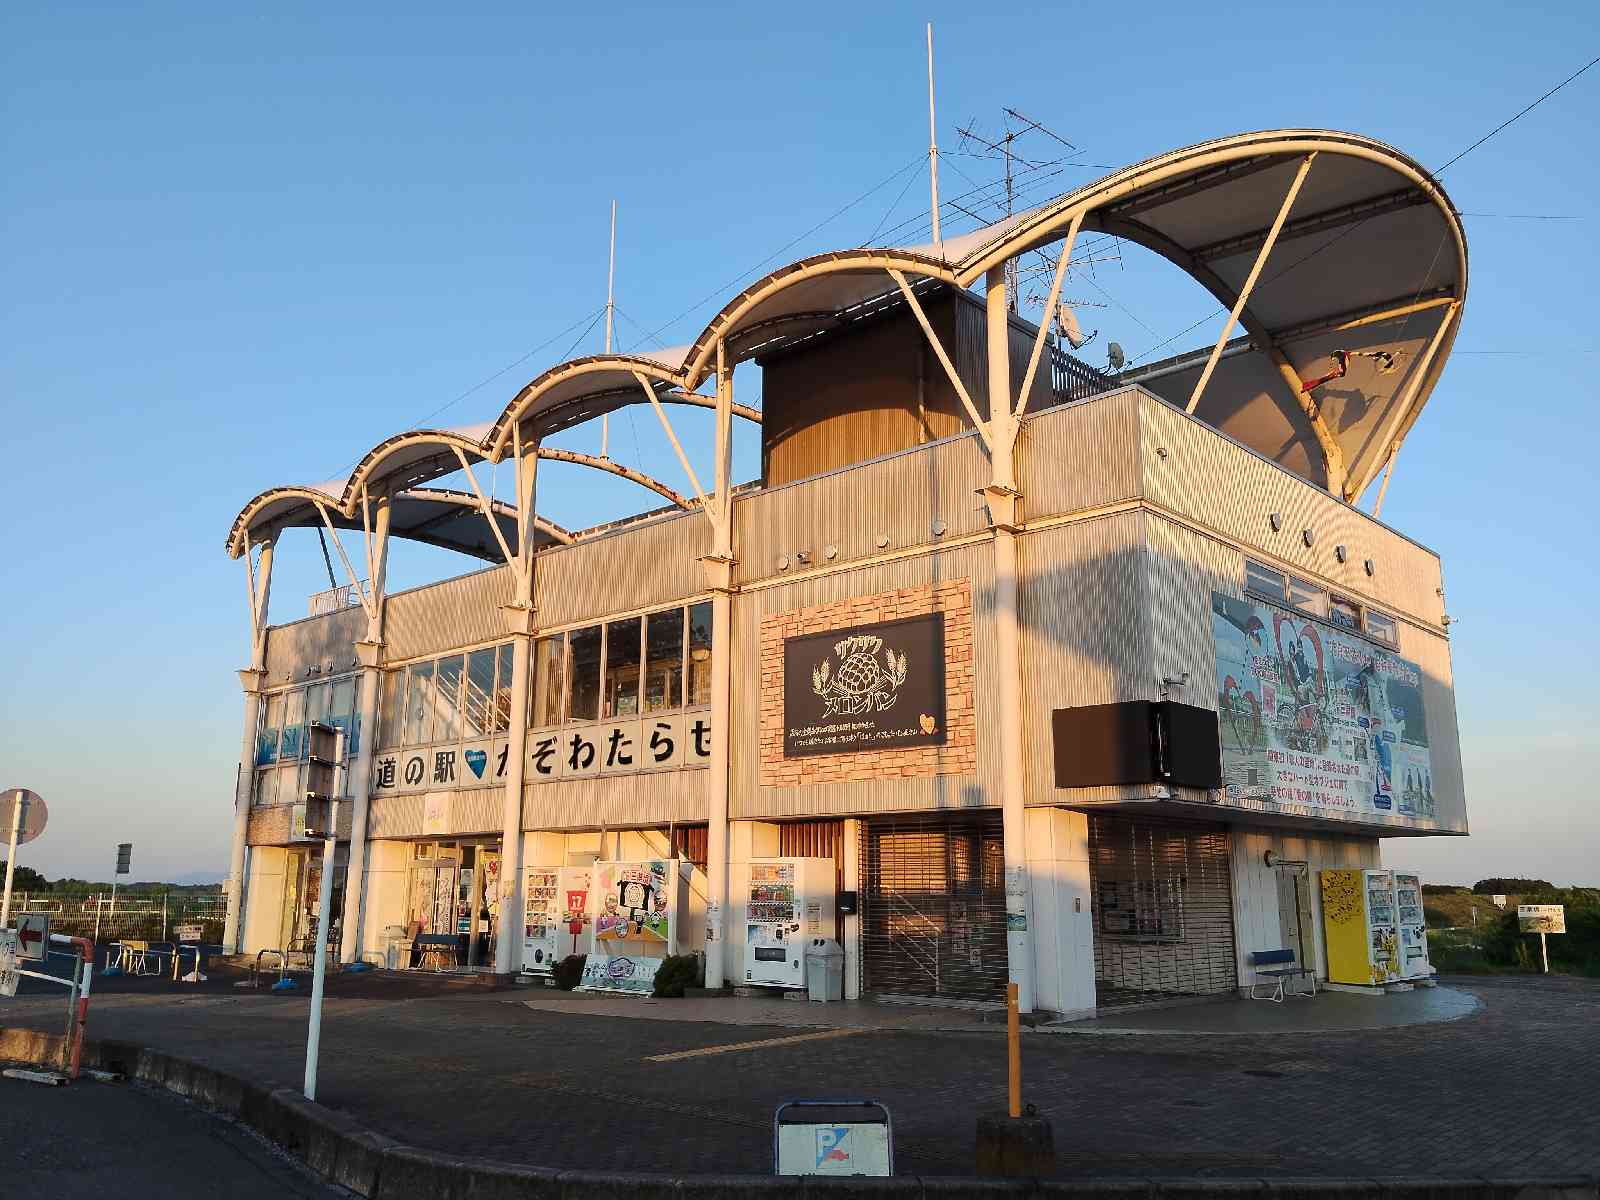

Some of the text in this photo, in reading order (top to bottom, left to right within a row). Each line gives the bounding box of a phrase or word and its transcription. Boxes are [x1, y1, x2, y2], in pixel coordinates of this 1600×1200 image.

[821, 691, 898, 719] メロンパン
[376, 750, 456, 789] 道の駅
[816, 1130, 836, 1154] P
